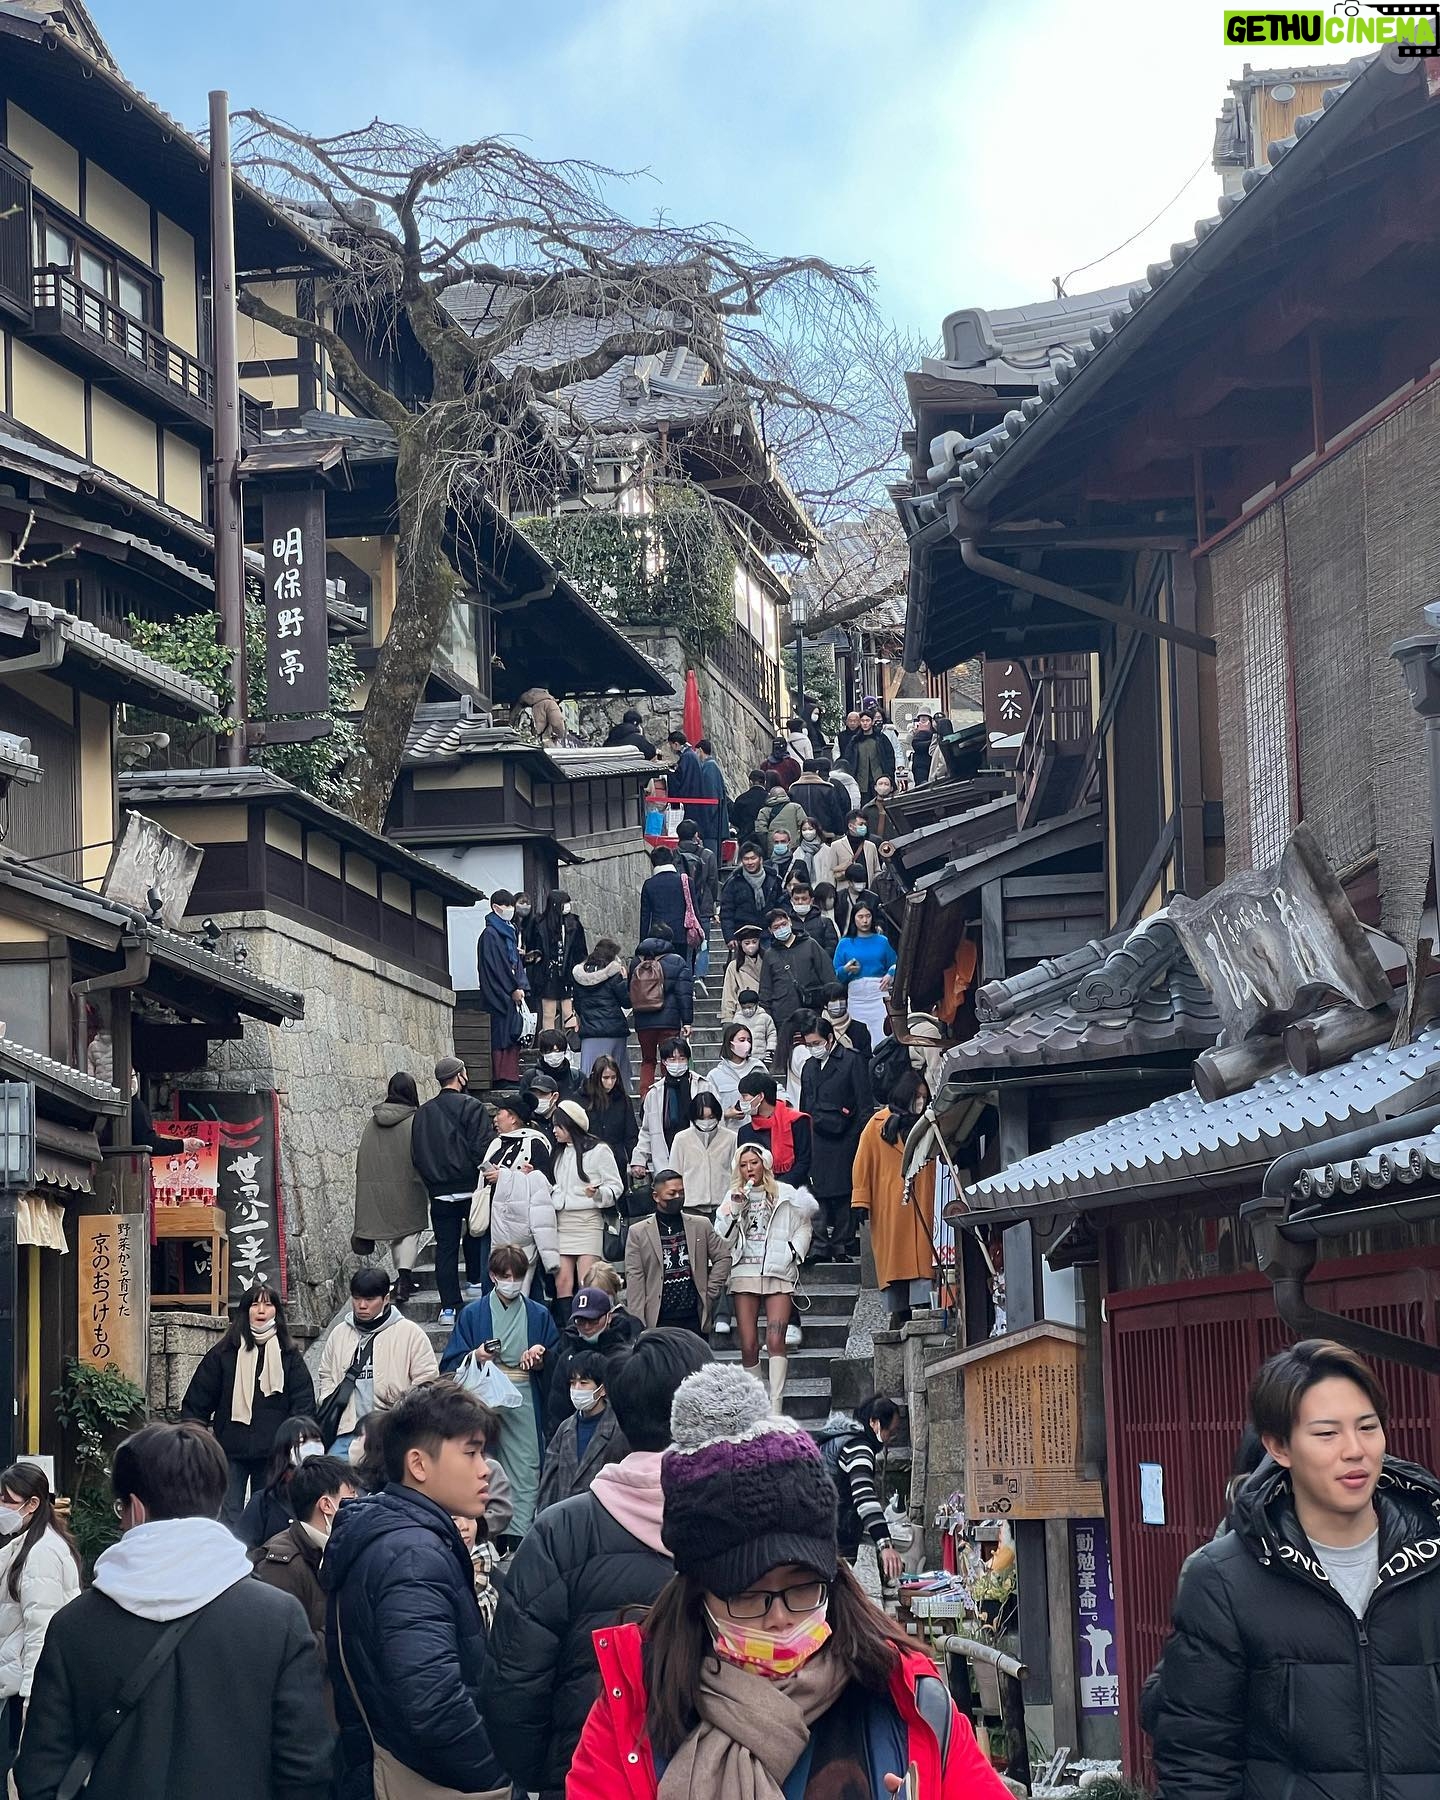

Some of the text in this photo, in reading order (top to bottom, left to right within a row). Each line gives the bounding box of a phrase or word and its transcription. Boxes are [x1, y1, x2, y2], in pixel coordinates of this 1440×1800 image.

[272, 527, 305, 686] 明保野亭
[91, 1232, 111, 1359] 京のおつけもの
[117, 1223, 131, 1317] 野菜から育てた
[578, 1295, 588, 1308] D
